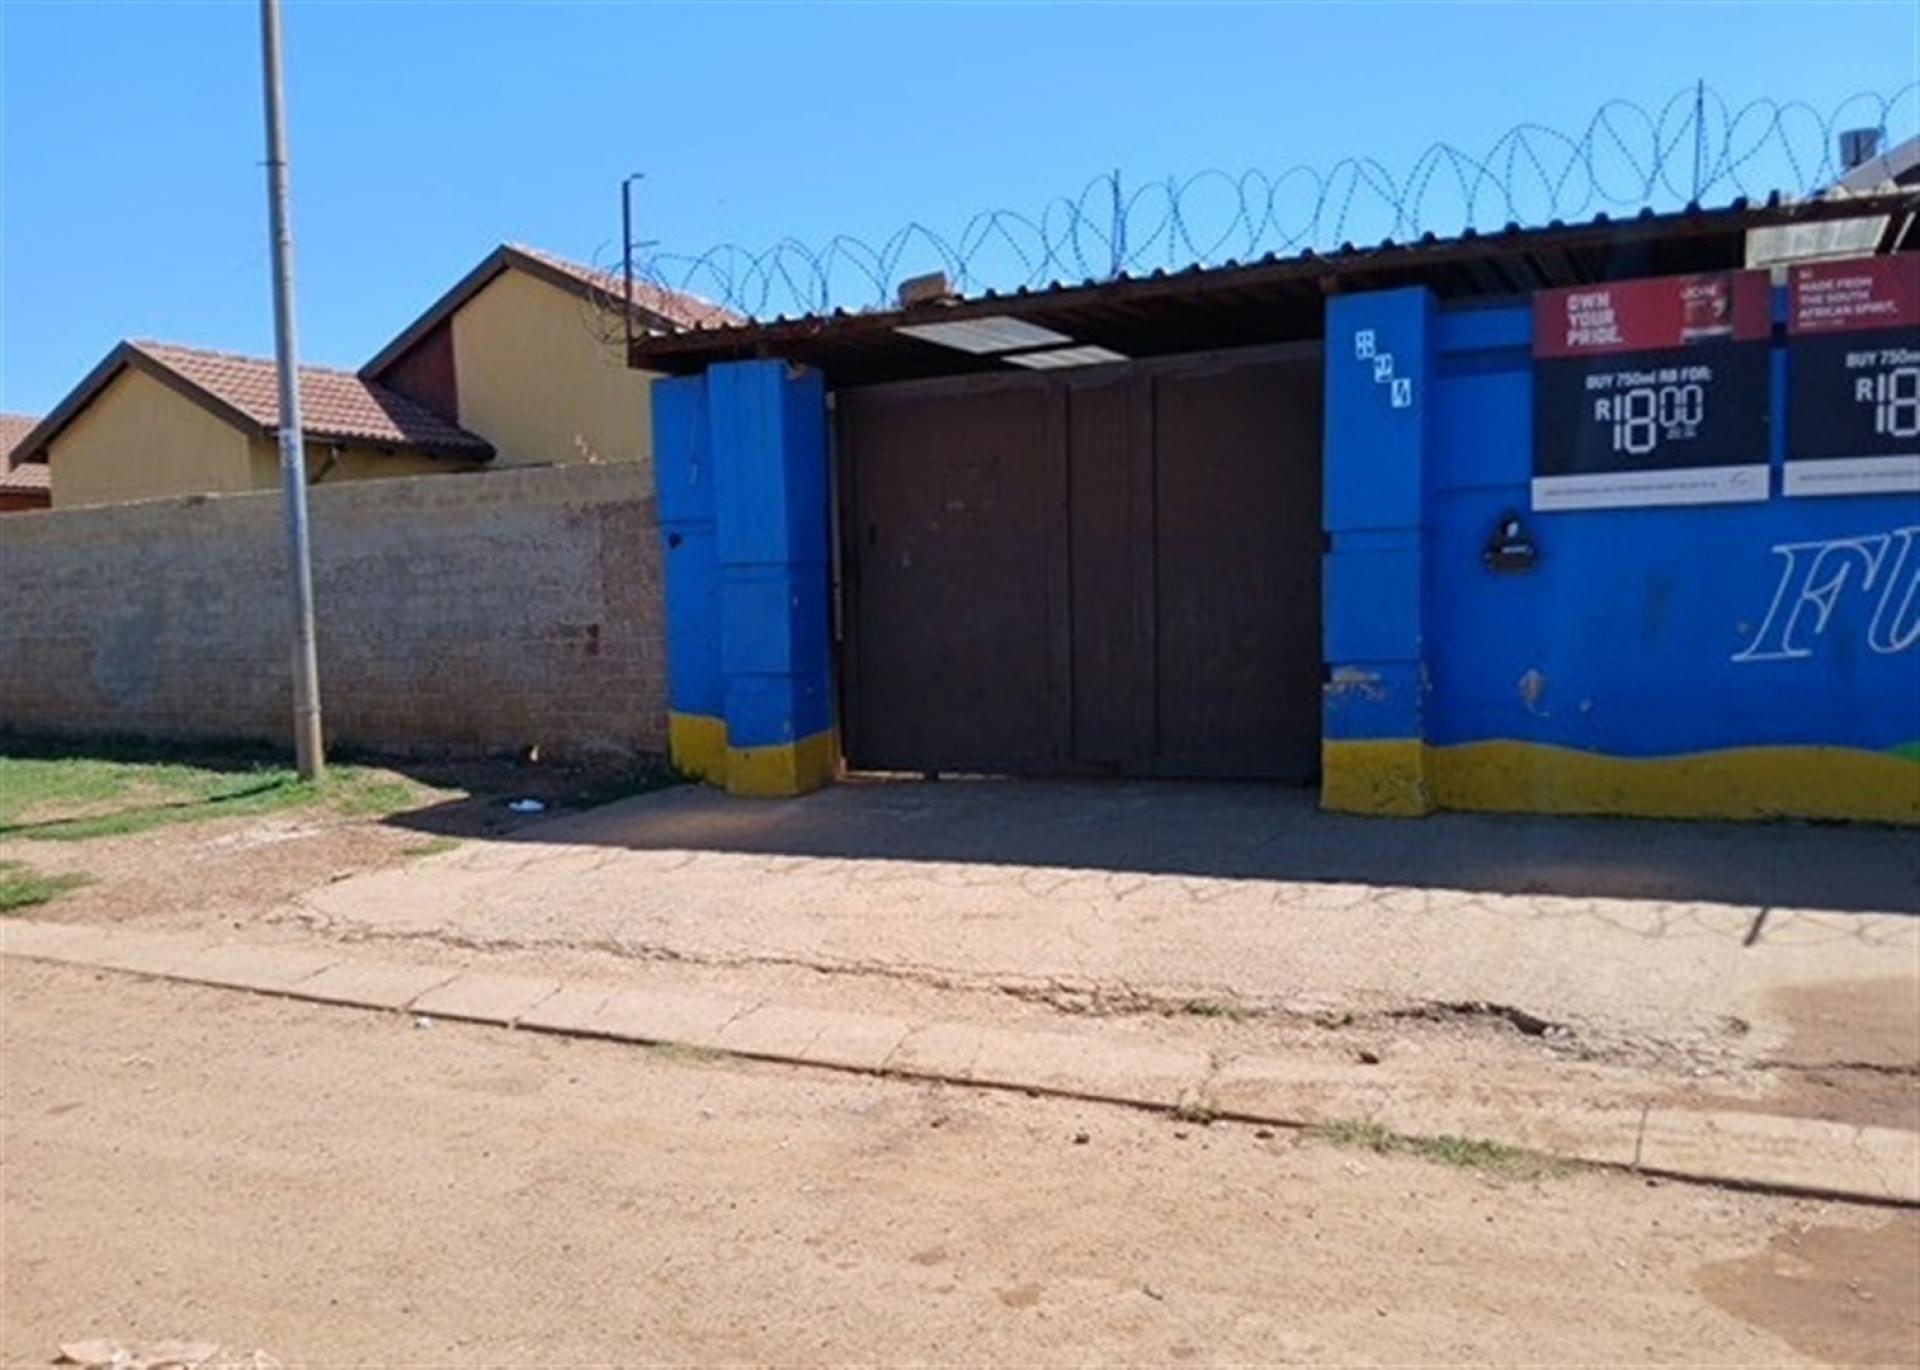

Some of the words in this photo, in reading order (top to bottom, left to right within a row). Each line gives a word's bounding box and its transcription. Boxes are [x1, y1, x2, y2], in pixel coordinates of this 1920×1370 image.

[1567, 291, 1610, 311] OWN
[1568, 309, 1615, 328] YOUR
[1799, 306, 1852, 318] AFRICAN
[1846, 351, 1877, 368] BUY
[1585, 374, 1615, 389] BUY
